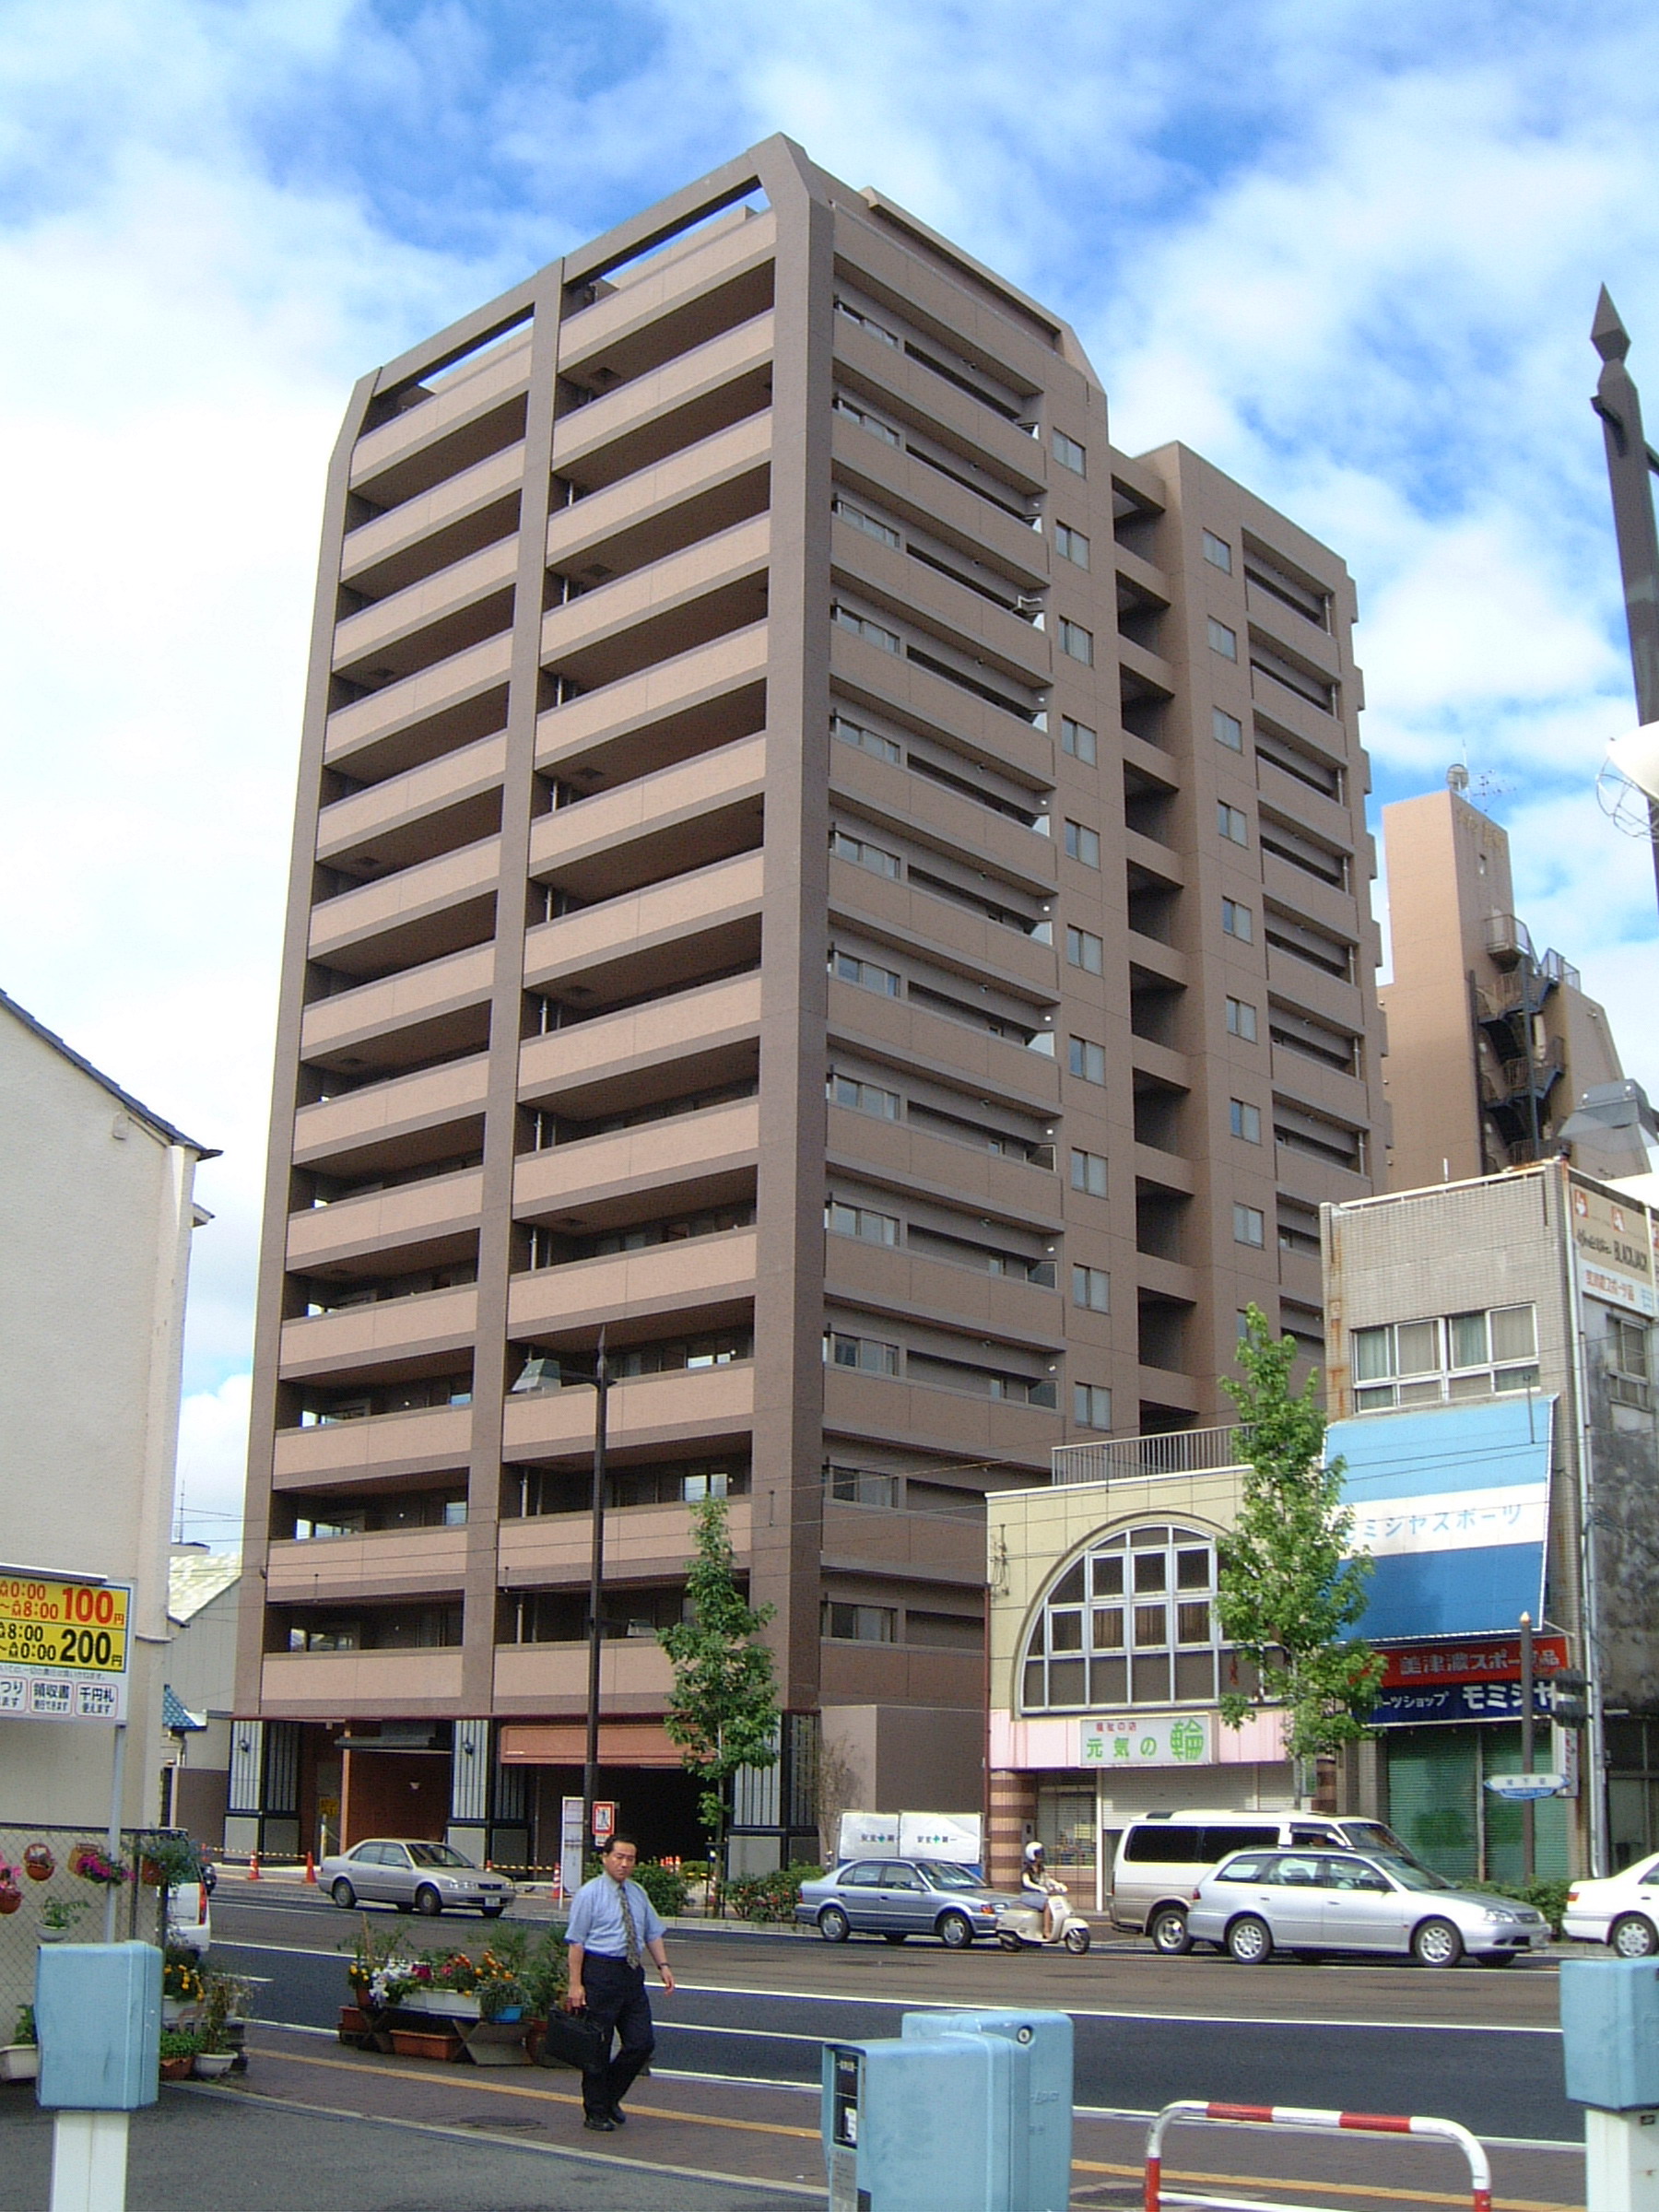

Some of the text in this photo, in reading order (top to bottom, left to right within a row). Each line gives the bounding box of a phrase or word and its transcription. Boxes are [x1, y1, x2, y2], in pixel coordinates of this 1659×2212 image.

[1399, 1648, 1560, 1677] 美津濃スポー品
[79, 1687, 115, 1703] 千円札
